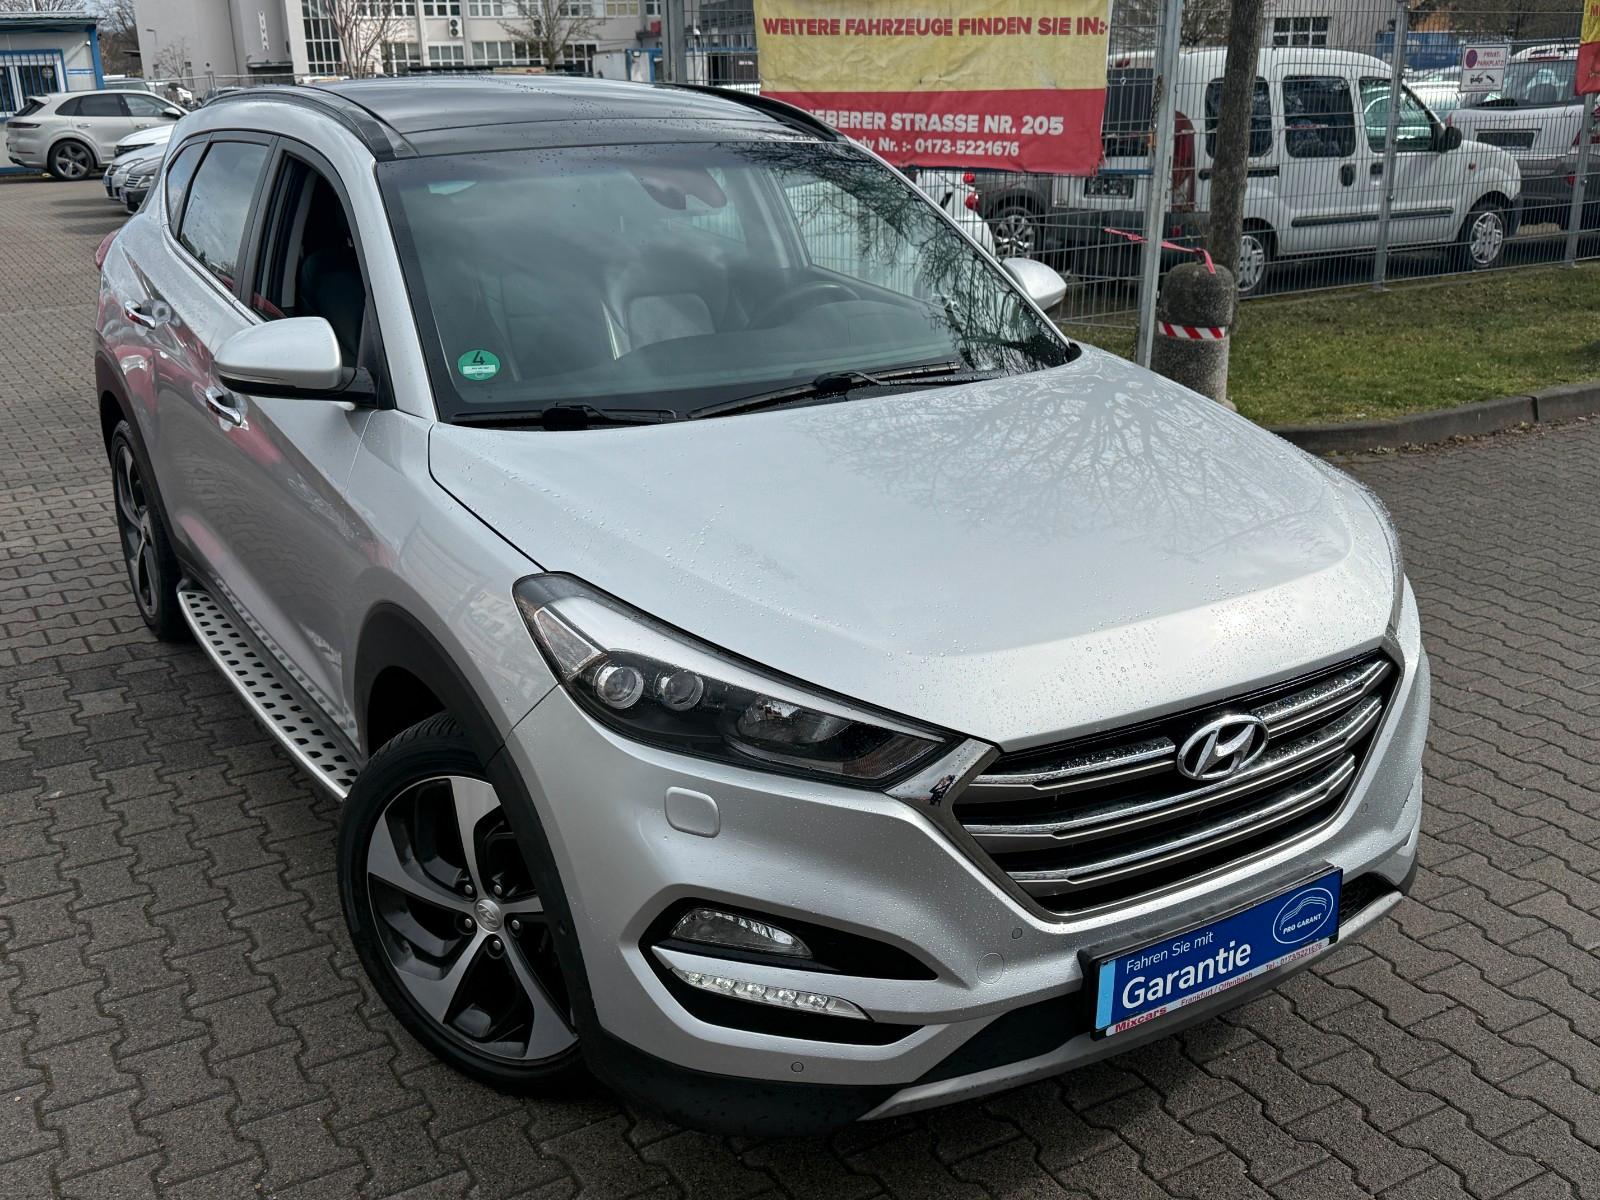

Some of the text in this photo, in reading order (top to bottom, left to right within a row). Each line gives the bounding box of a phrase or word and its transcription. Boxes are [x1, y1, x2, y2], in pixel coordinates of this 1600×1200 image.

[763, 18, 841, 36] WEITERE
[845, 18, 953, 37] FAHRZEUGE
[958, 17, 1032, 36] FINDEN
[1037, 17, 1072, 36] SIE
[890, 112, 980, 134] STRASSE
[984, 116, 1016, 135] NR.
[1020, 116, 1064, 136] 205
[878, 137, 899, 152] Nr.
[915, 139, 1020, 157] 0173-5221676
[472, 350, 485, 365] 4
[1282, 913, 1322, 935] PRO GARANT
[1126, 931, 1214, 974] Fahren Sie mit
[1122, 940, 1251, 1009] Garantie
[1115, 1006, 1168, 1034] Mixcars
